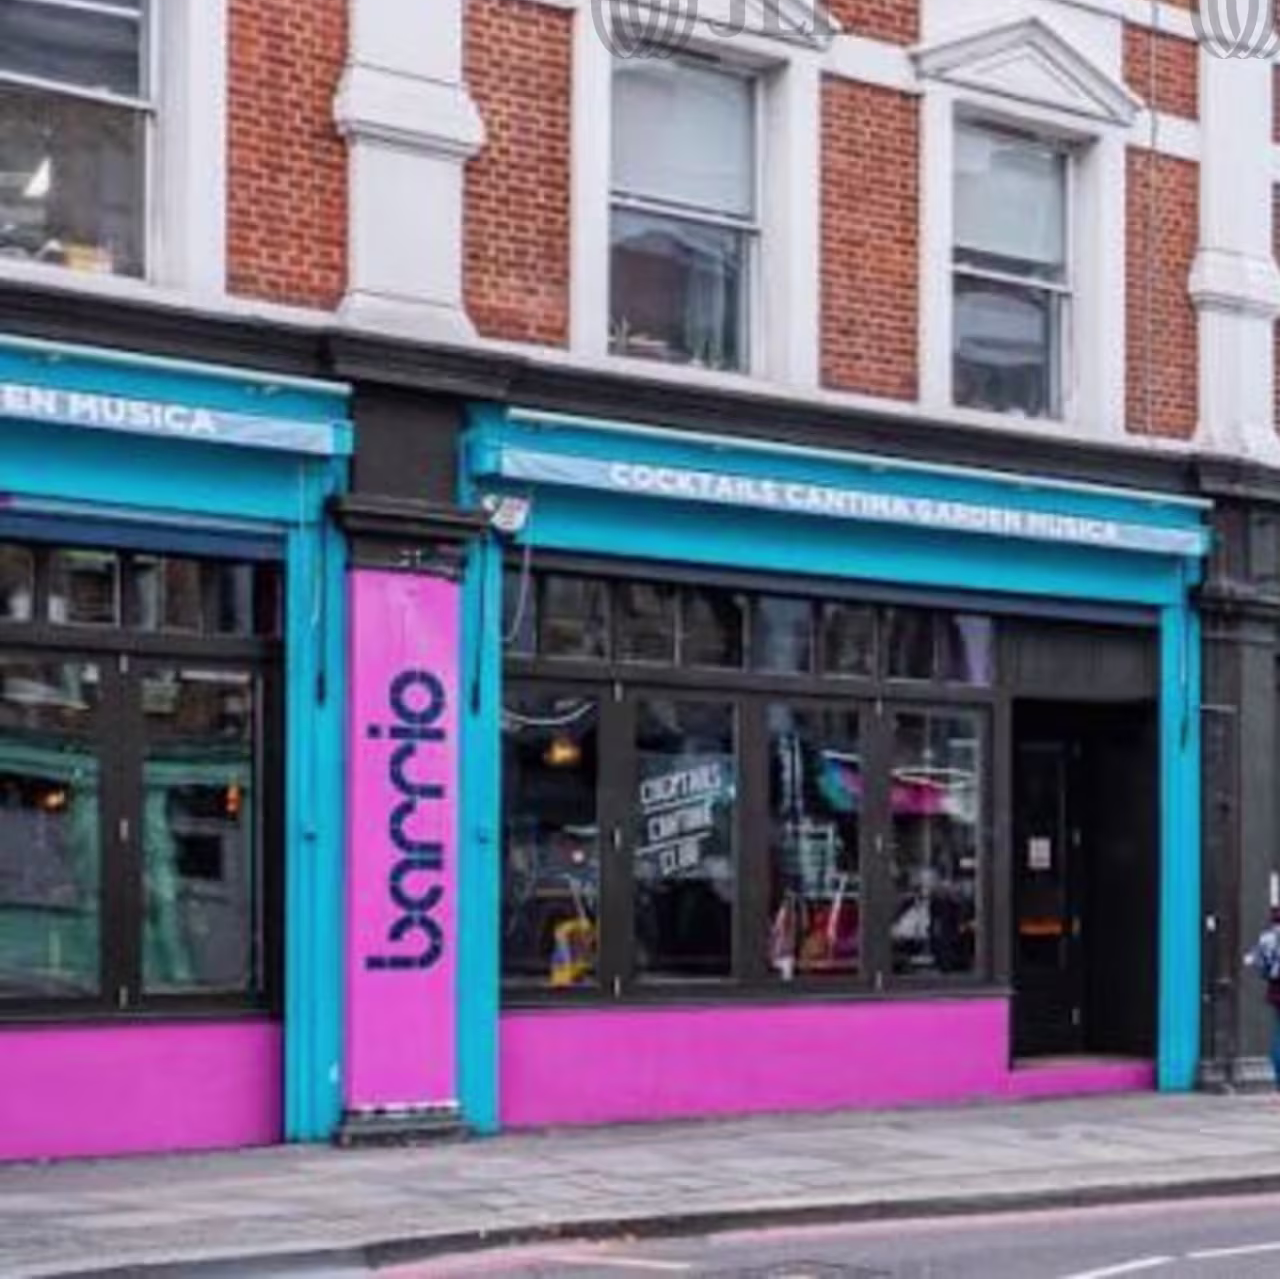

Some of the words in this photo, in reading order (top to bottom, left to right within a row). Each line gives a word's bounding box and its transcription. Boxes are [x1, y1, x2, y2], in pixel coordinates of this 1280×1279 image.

[67, 391, 216, 435] MUSICA
[608, 462, 785, 506] COCKTAILS
[365, 669, 446, 971] barrio
